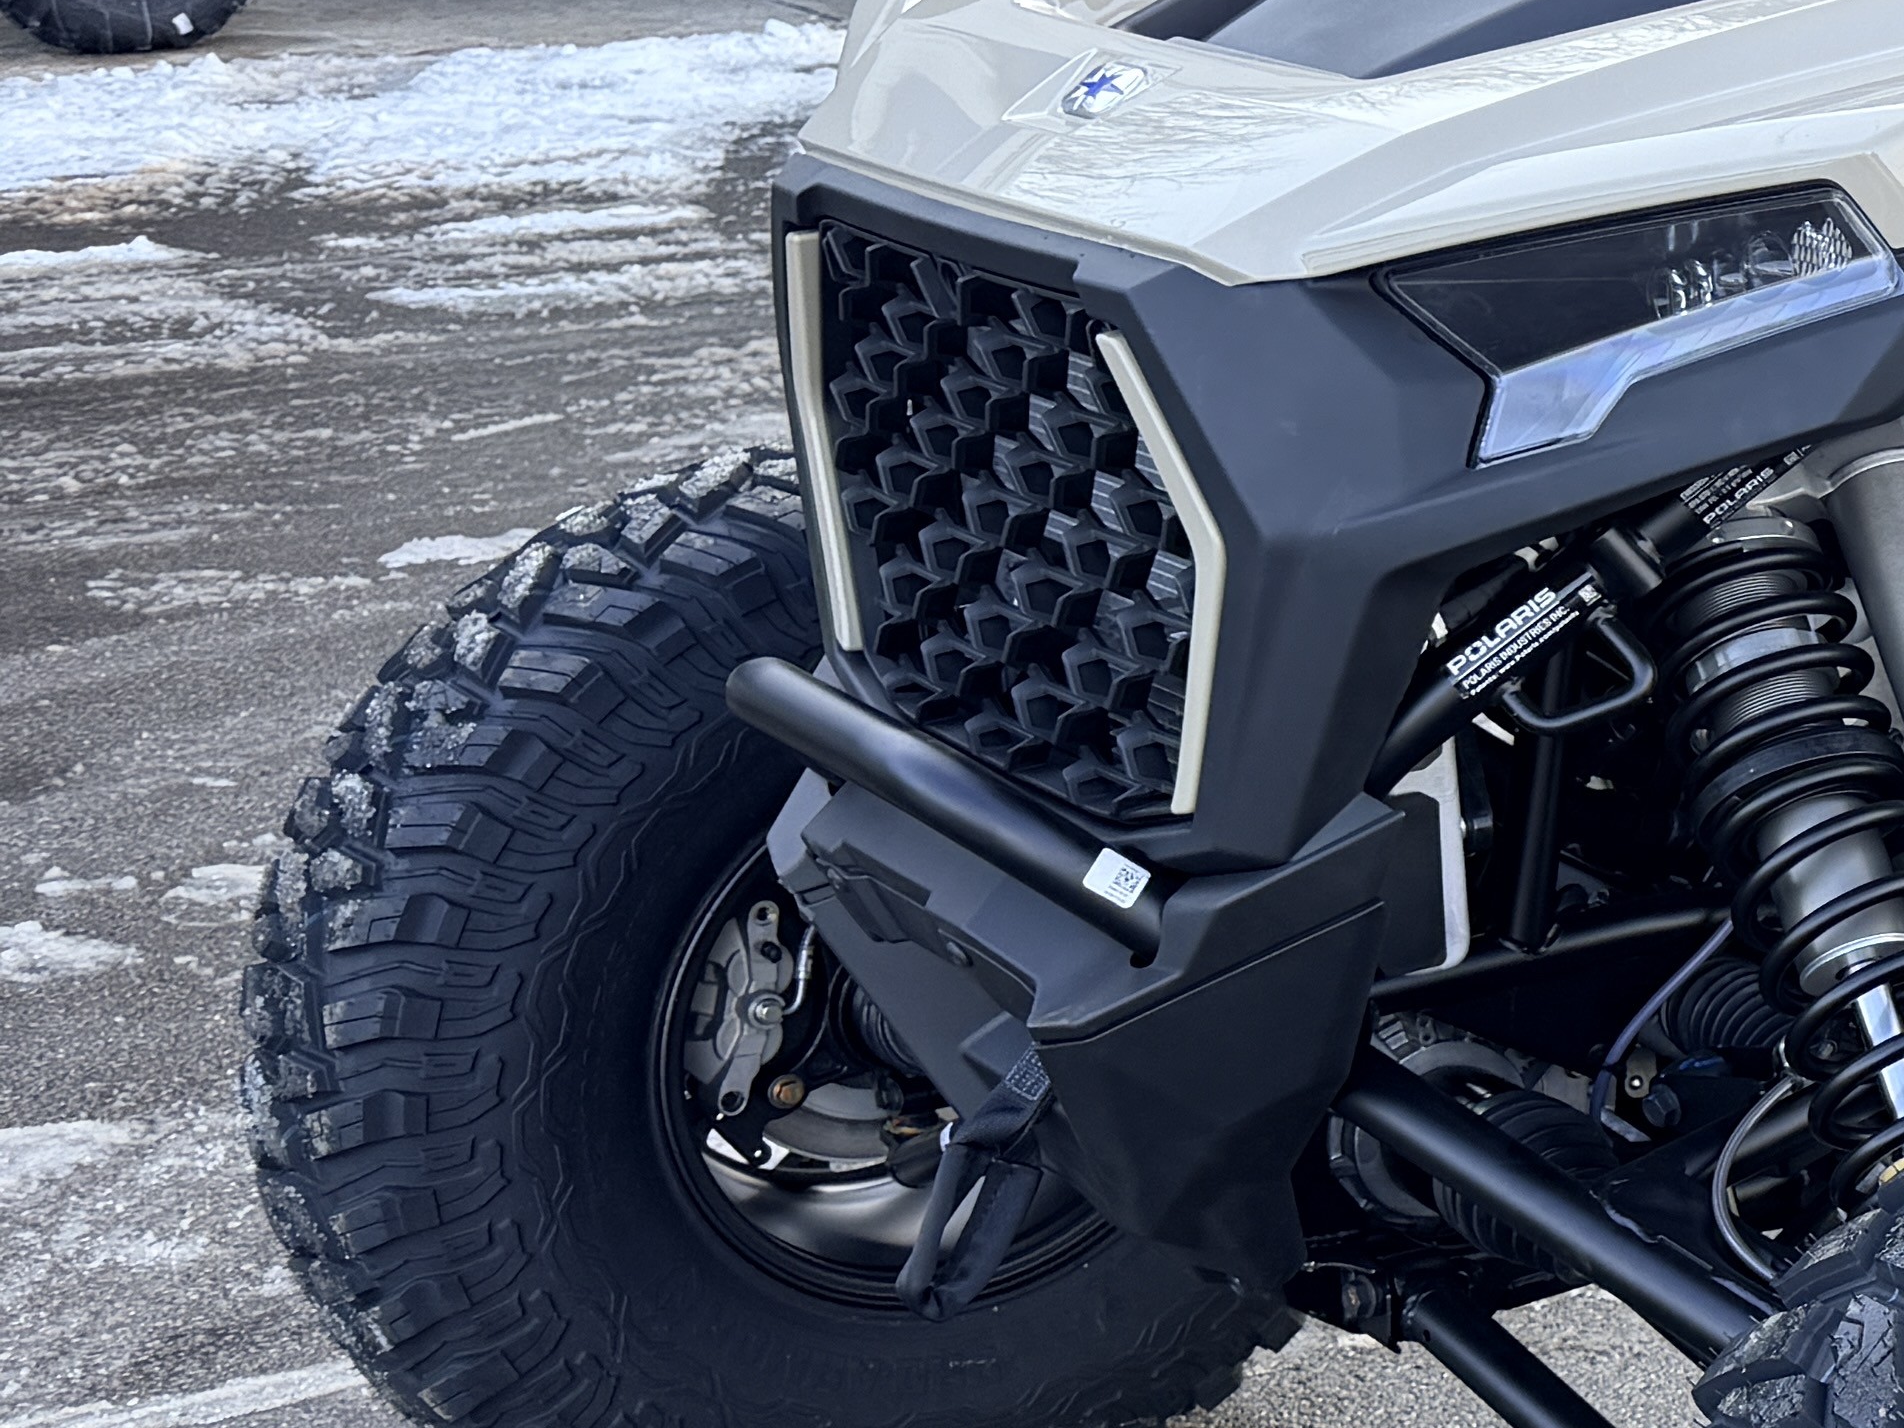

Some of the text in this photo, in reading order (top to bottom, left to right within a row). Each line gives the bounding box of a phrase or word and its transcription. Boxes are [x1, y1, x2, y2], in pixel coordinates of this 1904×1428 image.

[1703, 467, 1774, 524] POLARIS
[1447, 587, 1557, 676] POLARIS
[1462, 657, 1503, 690] POLARIS
[1500, 620, 1551, 660] INDUSTRIES
